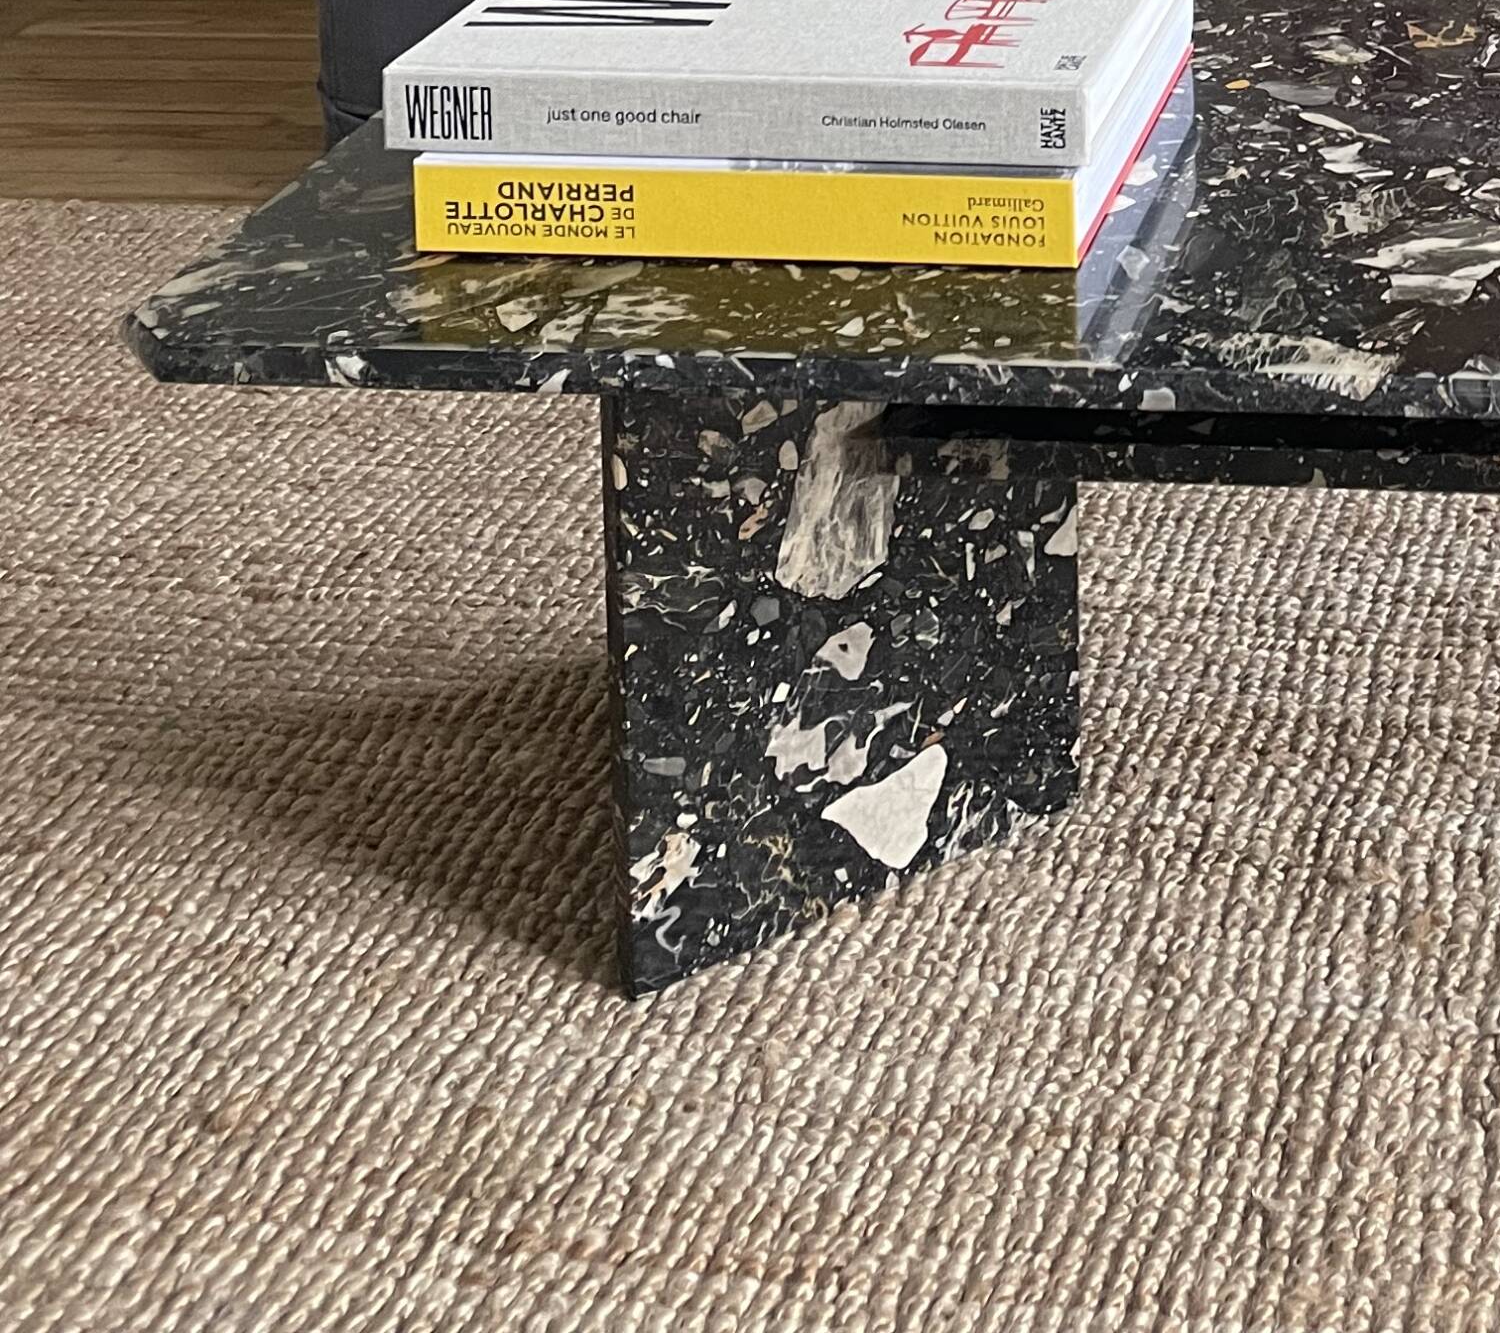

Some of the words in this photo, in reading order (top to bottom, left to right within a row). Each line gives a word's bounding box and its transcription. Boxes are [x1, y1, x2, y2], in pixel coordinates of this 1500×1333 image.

[405, 84, 493, 141] WEGNER
[546, 106, 576, 125] just
[580, 109, 610, 123] one
[615, 109, 657, 126] good
[661, 109, 702, 125] chair
[821, 115, 877, 129] Christian
[880, 116, 939, 131] Holmsted
[942, 118, 987, 131] Olesen
[1040, 107, 1053, 149] HATJE
[1051, 108, 1066, 149] CANTZ
[498, 181, 634, 202] PERRIAND
[446, 201, 604, 222] CHARLOTTE
[967, 196, 1045, 212] Gallimard
[611, 207, 634, 221] DE
[902, 212, 983, 228] VUITTON
[447, 222, 535, 237] NOUVEAU
[991, 215, 1046, 230] LOUIS
[542, 223, 608, 239] MONDE
[615, 225, 635, 239] LE
[934, 231, 1046, 247] FONDATION
